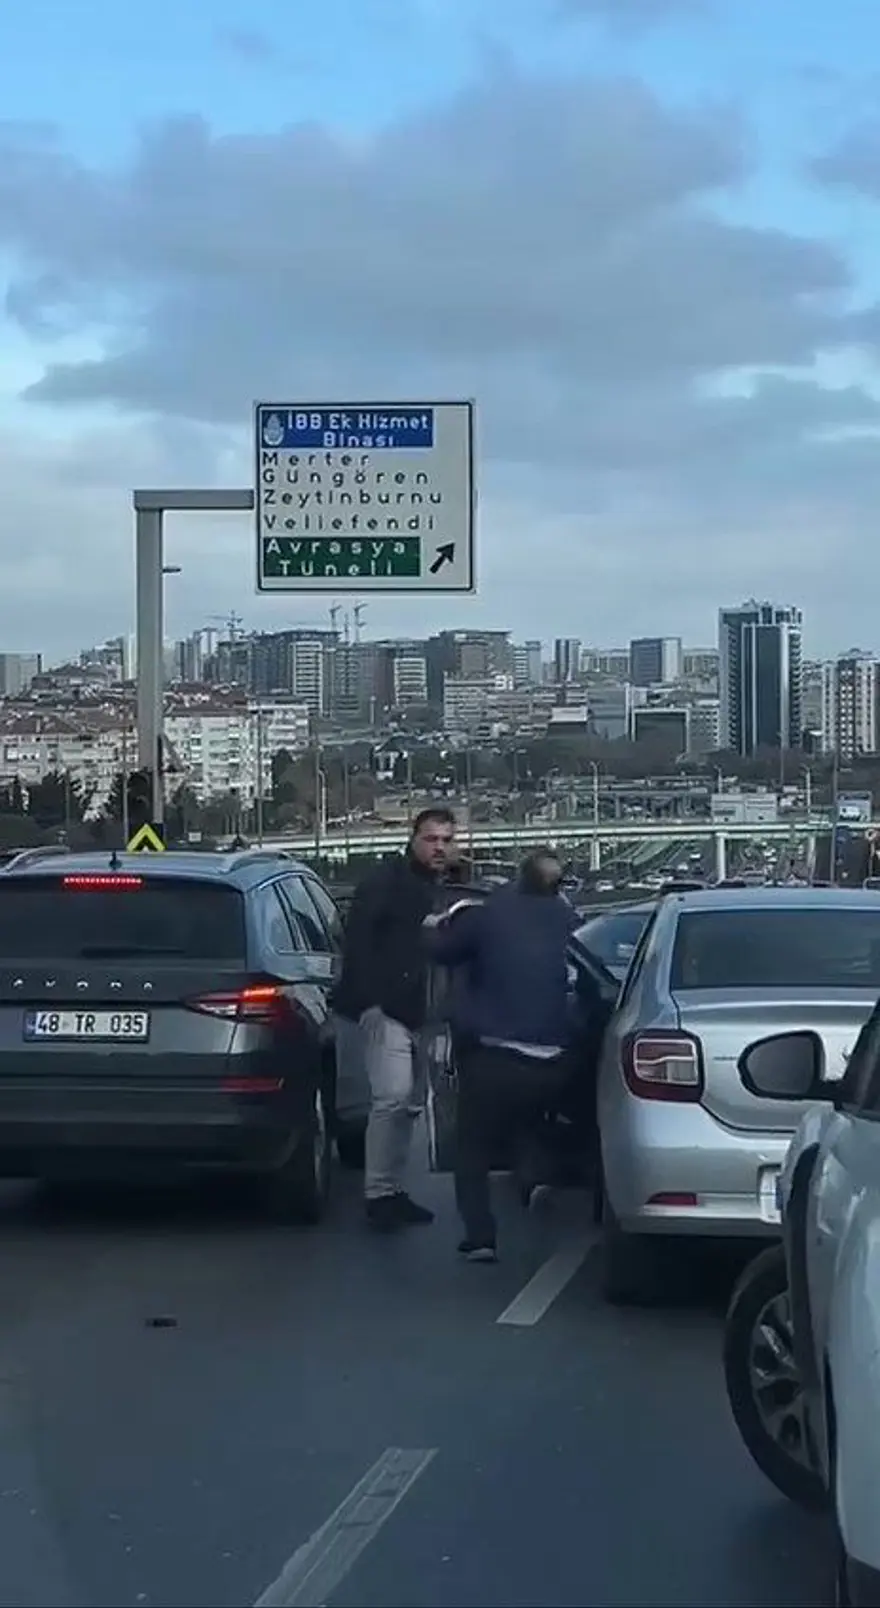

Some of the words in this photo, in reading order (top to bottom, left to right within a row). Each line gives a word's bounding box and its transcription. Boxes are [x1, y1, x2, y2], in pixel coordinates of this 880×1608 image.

[329, 412, 351, 430] Ek
[358, 412, 428, 430] Hizmet
[323, 431, 394, 447] Binası
[262, 452, 369, 466] Merter
[262, 468, 428, 488] Güngören
[264, 489, 442, 509] Zeytinburnu
[264, 514, 434, 530] Veliefendi
[266, 538, 405, 558] Avrasya
[279, 559, 392, 576] Tüneli
[37, 1014, 60, 1033] 48
[75, 1014, 96, 1033] TR
[110, 1014, 144, 1033] 035
